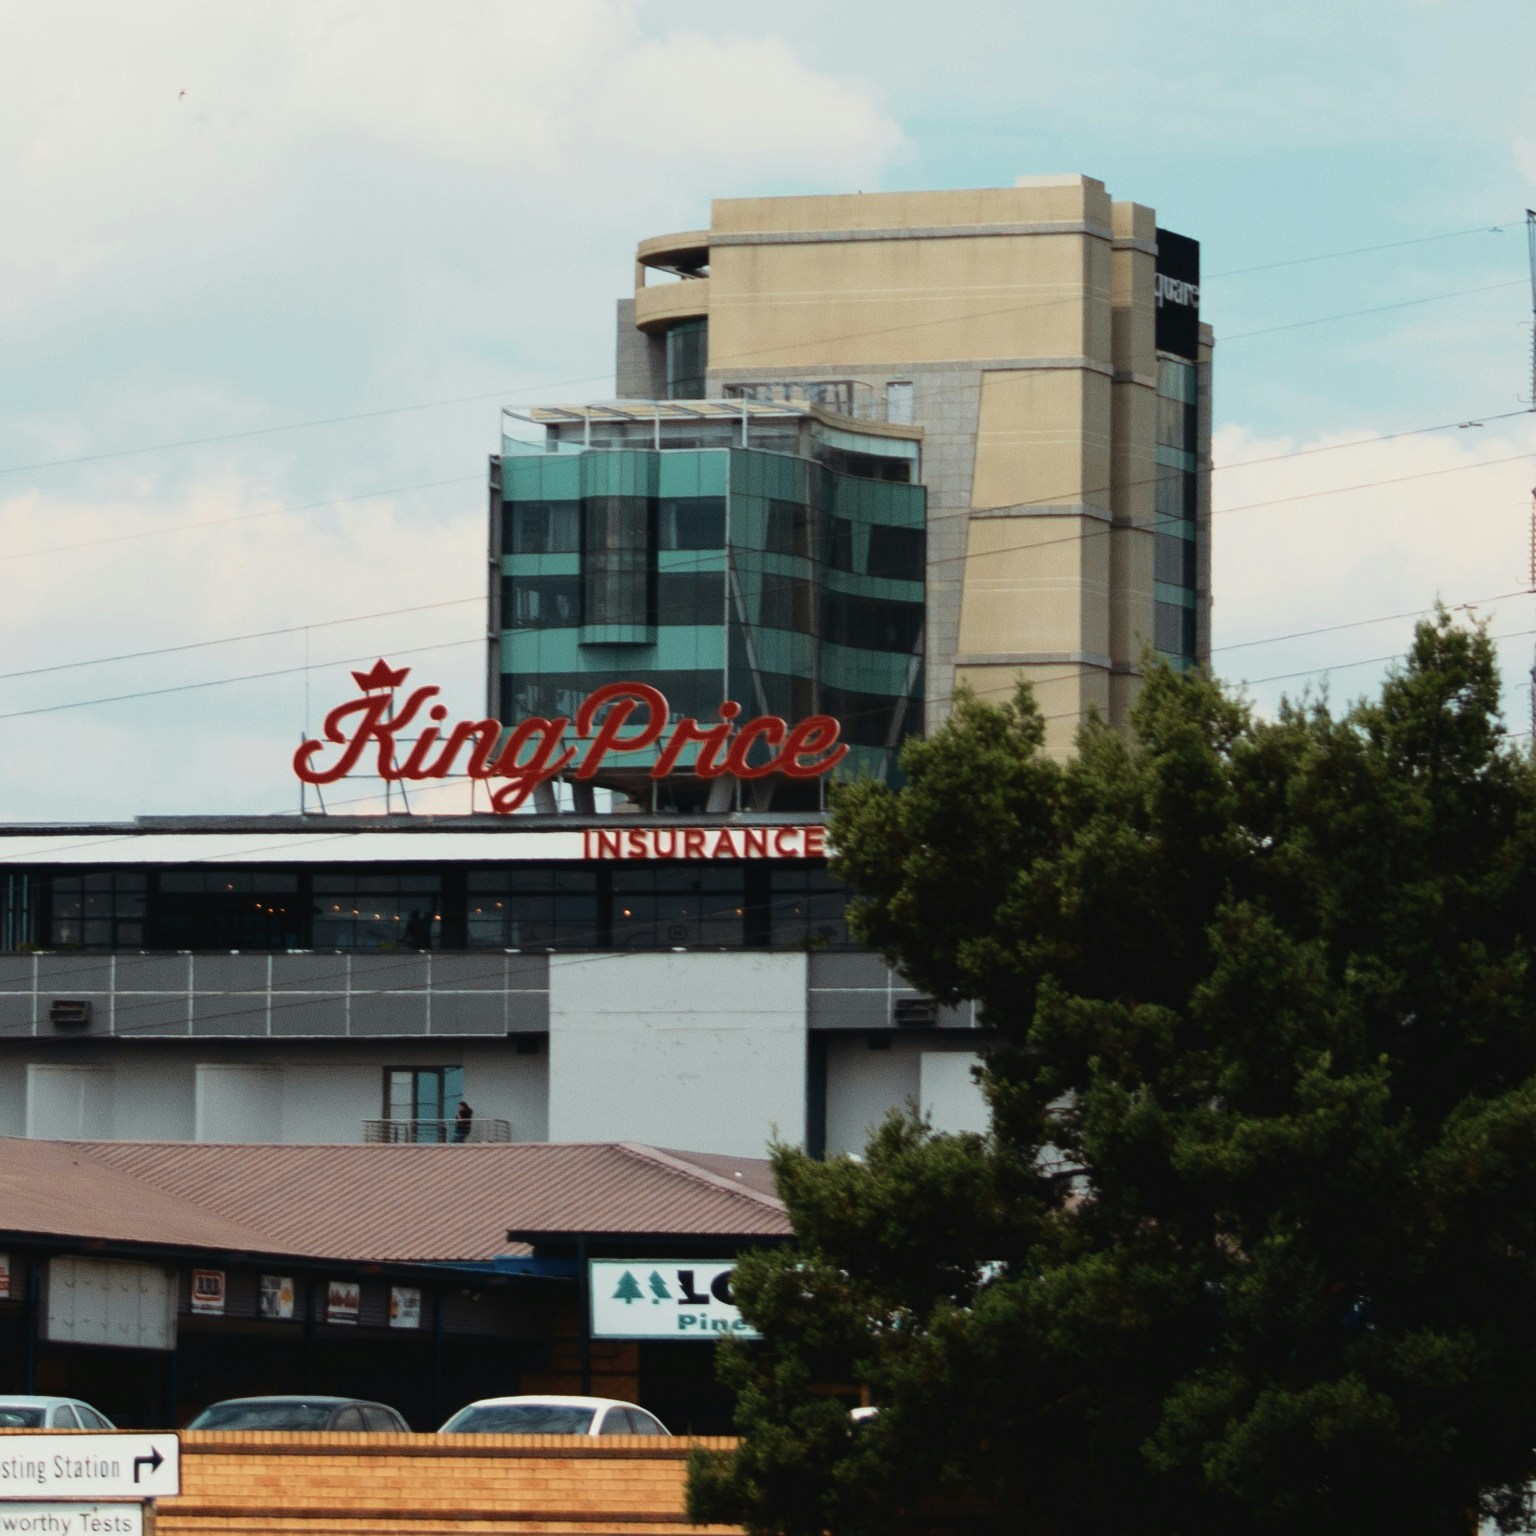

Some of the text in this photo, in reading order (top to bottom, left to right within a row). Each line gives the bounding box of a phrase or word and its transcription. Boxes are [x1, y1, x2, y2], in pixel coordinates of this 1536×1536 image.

[293, 681, 851, 814] King Price
[583, 826, 825, 860] INSURANCE
[53, 1454, 121, 1479] Station
[79, 1512, 133, 1533] Tests
